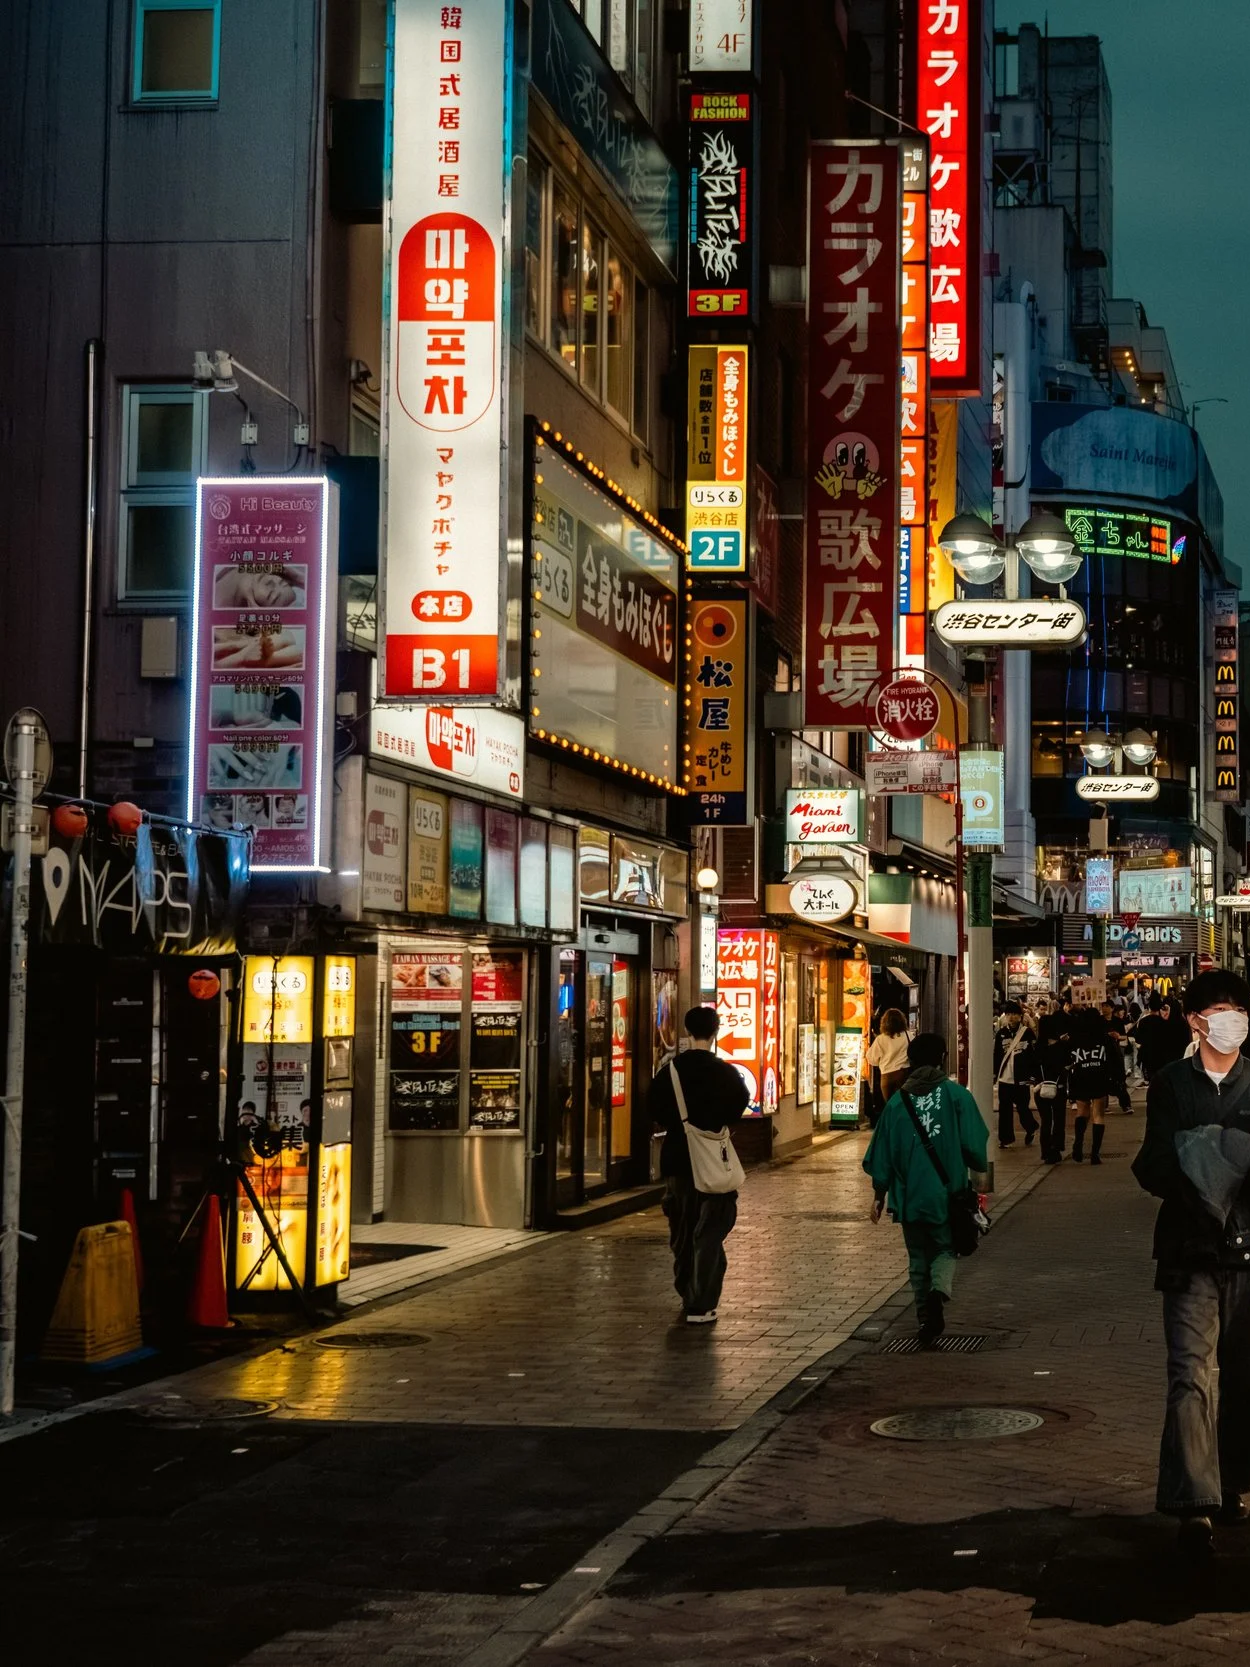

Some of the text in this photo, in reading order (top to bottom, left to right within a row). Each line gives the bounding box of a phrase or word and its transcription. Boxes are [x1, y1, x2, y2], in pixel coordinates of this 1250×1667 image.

[716, 33, 746, 54] 4F
[437, 6, 462, 198] 韓国式居酒屋
[693, 107, 747, 120] FASHION
[702, 95, 738, 108] ROCK
[696, 294, 741, 312] 3F
[423, 228, 470, 416] 마약포차
[722, 356, 741, 476] 全身もみほぐし
[817, 149, 885, 710] カラオケ 歌広場
[240, 497, 318, 514] Hi Beauty
[695, 490, 738, 504] りらくる
[431, 447, 456, 576] マヤクポチャ
[694, 511, 739, 526] 渋谷店
[1070, 516, 1149, 549] 金ちゃん
[697, 536, 736, 561] 2F
[419, 595, 464, 618] 本店
[581, 544, 673, 664] 全身もみほぐし
[942, 612, 1077, 630] 渋谷センター街
[411, 647, 471, 690] B1
[695, 654, 734, 732] 松屋
[883, 697, 935, 723] 消火栓
[427, 716, 476, 758] 마약포차
[695, 755, 708, 787] 定食
[707, 746, 719, 782] カレー
[719, 741, 733, 777] 牛めし
[700, 794, 726, 804] 24h
[789, 803, 843, 817] Miami
[703, 807, 721, 819] 1F
[803, 898, 841, 911] 大ホール
[811, 888, 835, 899] てんぐ
[1083, 924, 1183, 943] MDnald's
[764, 935, 778, 1062] カラオケ
